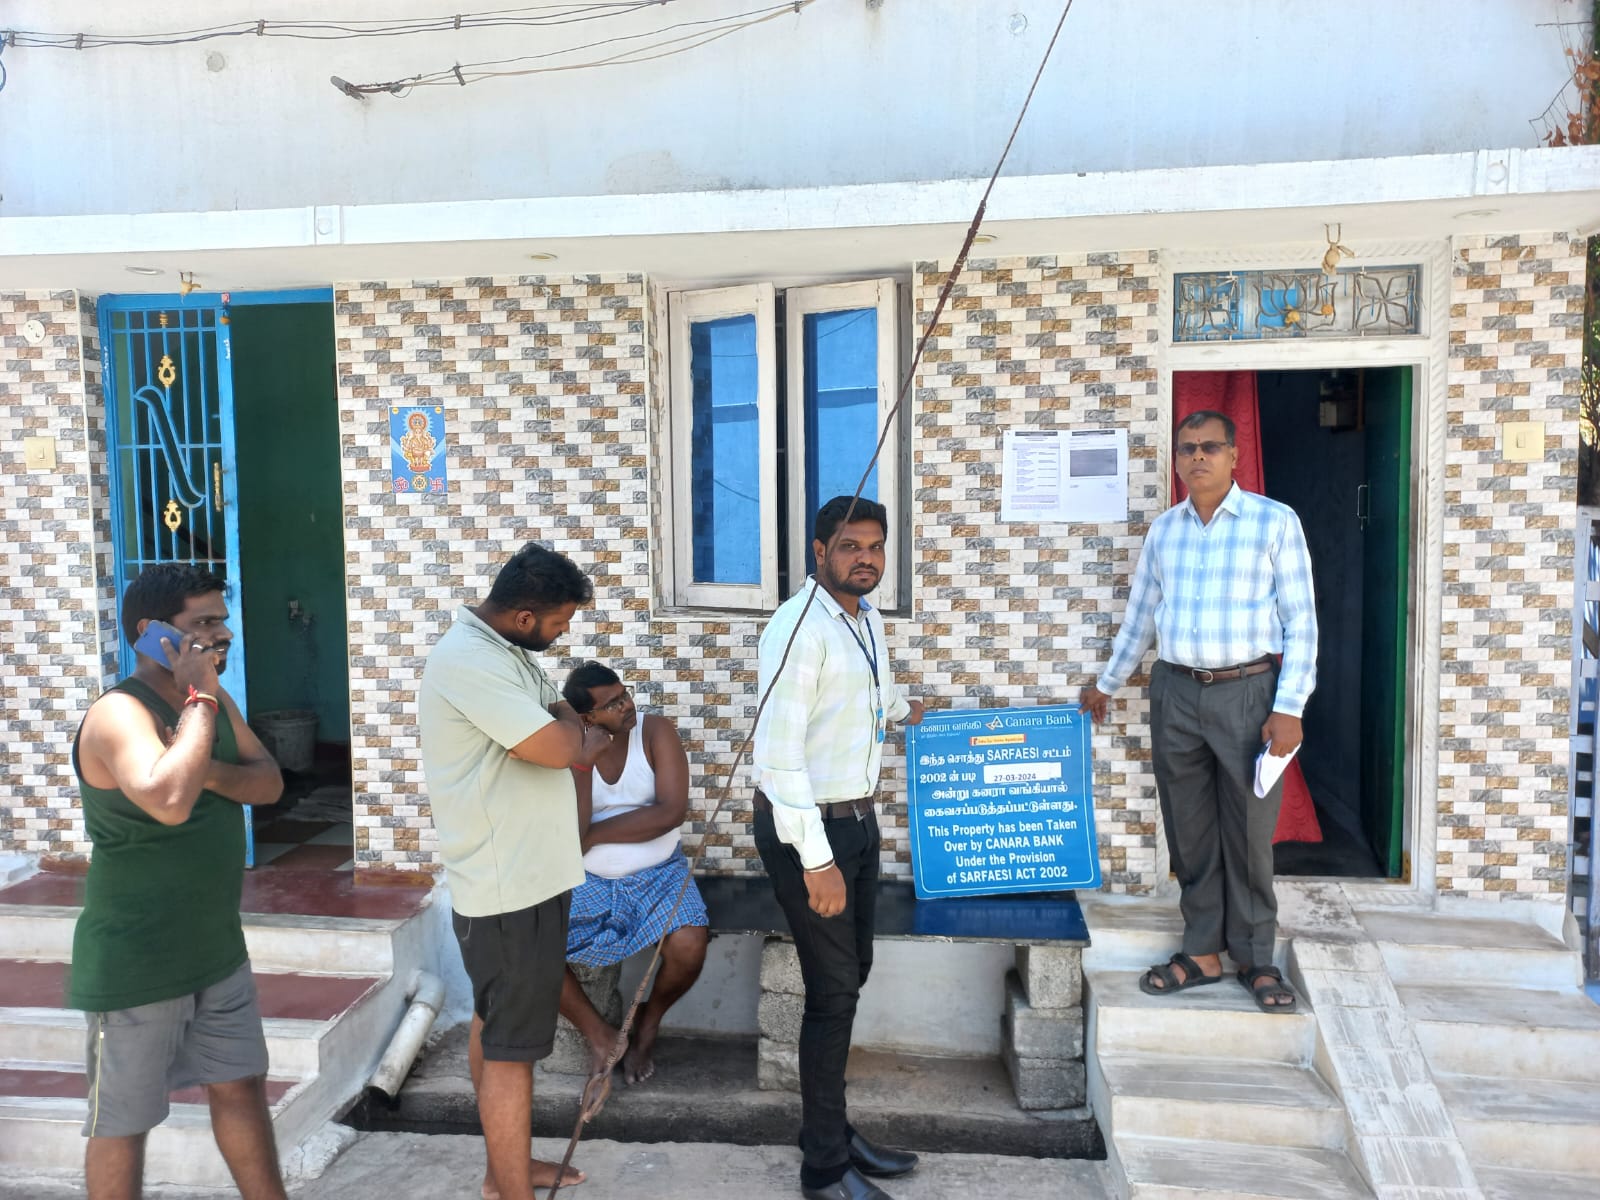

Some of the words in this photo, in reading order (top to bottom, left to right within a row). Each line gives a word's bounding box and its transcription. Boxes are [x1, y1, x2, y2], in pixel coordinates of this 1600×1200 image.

[1005, 716, 1042, 728] Canara
[1046, 714, 1073, 725] Bank
[920, 753, 945, 767] இந்த
[947, 751, 985, 765] சொத்து
[987, 747, 1039, 761] SARFAESI
[1042, 746, 1072, 758] சட்டம்
[920, 772, 947, 783] 2002
[994, 773, 1037, 782] 27-03-2024
[932, 787, 970, 801] அன்று
[972, 787, 1006, 798] கனரா
[1009, 782, 1068, 796] வங்கியால்
[928, 826, 949, 837] This
[953, 824, 995, 837] Property
[998, 822, 1016, 833] has
[1019, 820, 1043, 832] been
[1046, 819, 1077, 831] Taken
[944, 841, 967, 852] Over
[971, 839, 982, 852] by
[985, 836, 1031, 850] CANARA
[1034, 834, 1064, 847] BANK
[955, 855, 986, 867] Under
[989, 854, 1006, 865] the
[1009, 851, 1055, 864] Provision
[947, 873, 956, 884] of
[960, 869, 1012, 883] SARFAESI
[1016, 868, 1036, 879] ACT
[1040, 866, 1068, 879] 2002
